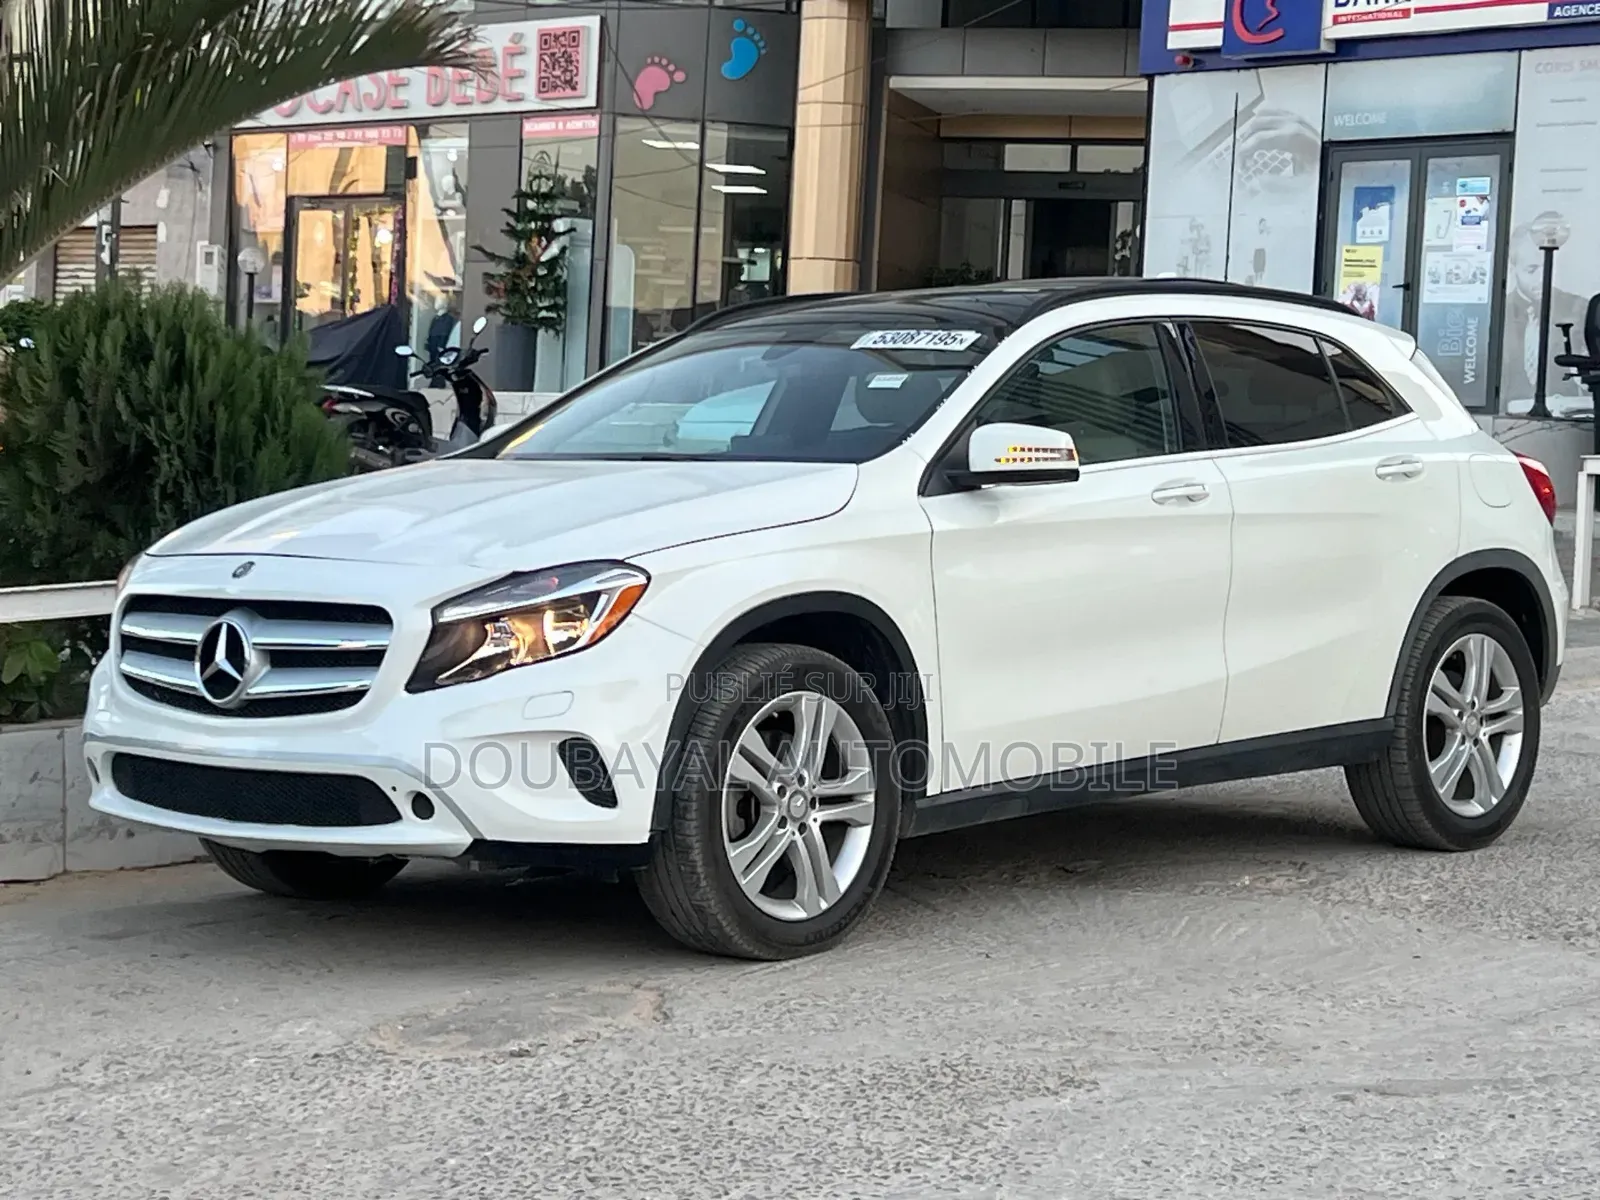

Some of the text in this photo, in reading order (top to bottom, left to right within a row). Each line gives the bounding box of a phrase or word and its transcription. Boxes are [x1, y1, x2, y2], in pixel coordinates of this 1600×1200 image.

[1337, 11, 1404, 23] INTERNATIONAL
[1553, 3, 1600, 17] AGENCE
[1333, 112, 1387, 127] WELCOME
[1463, 316, 1479, 384] WELCOME
